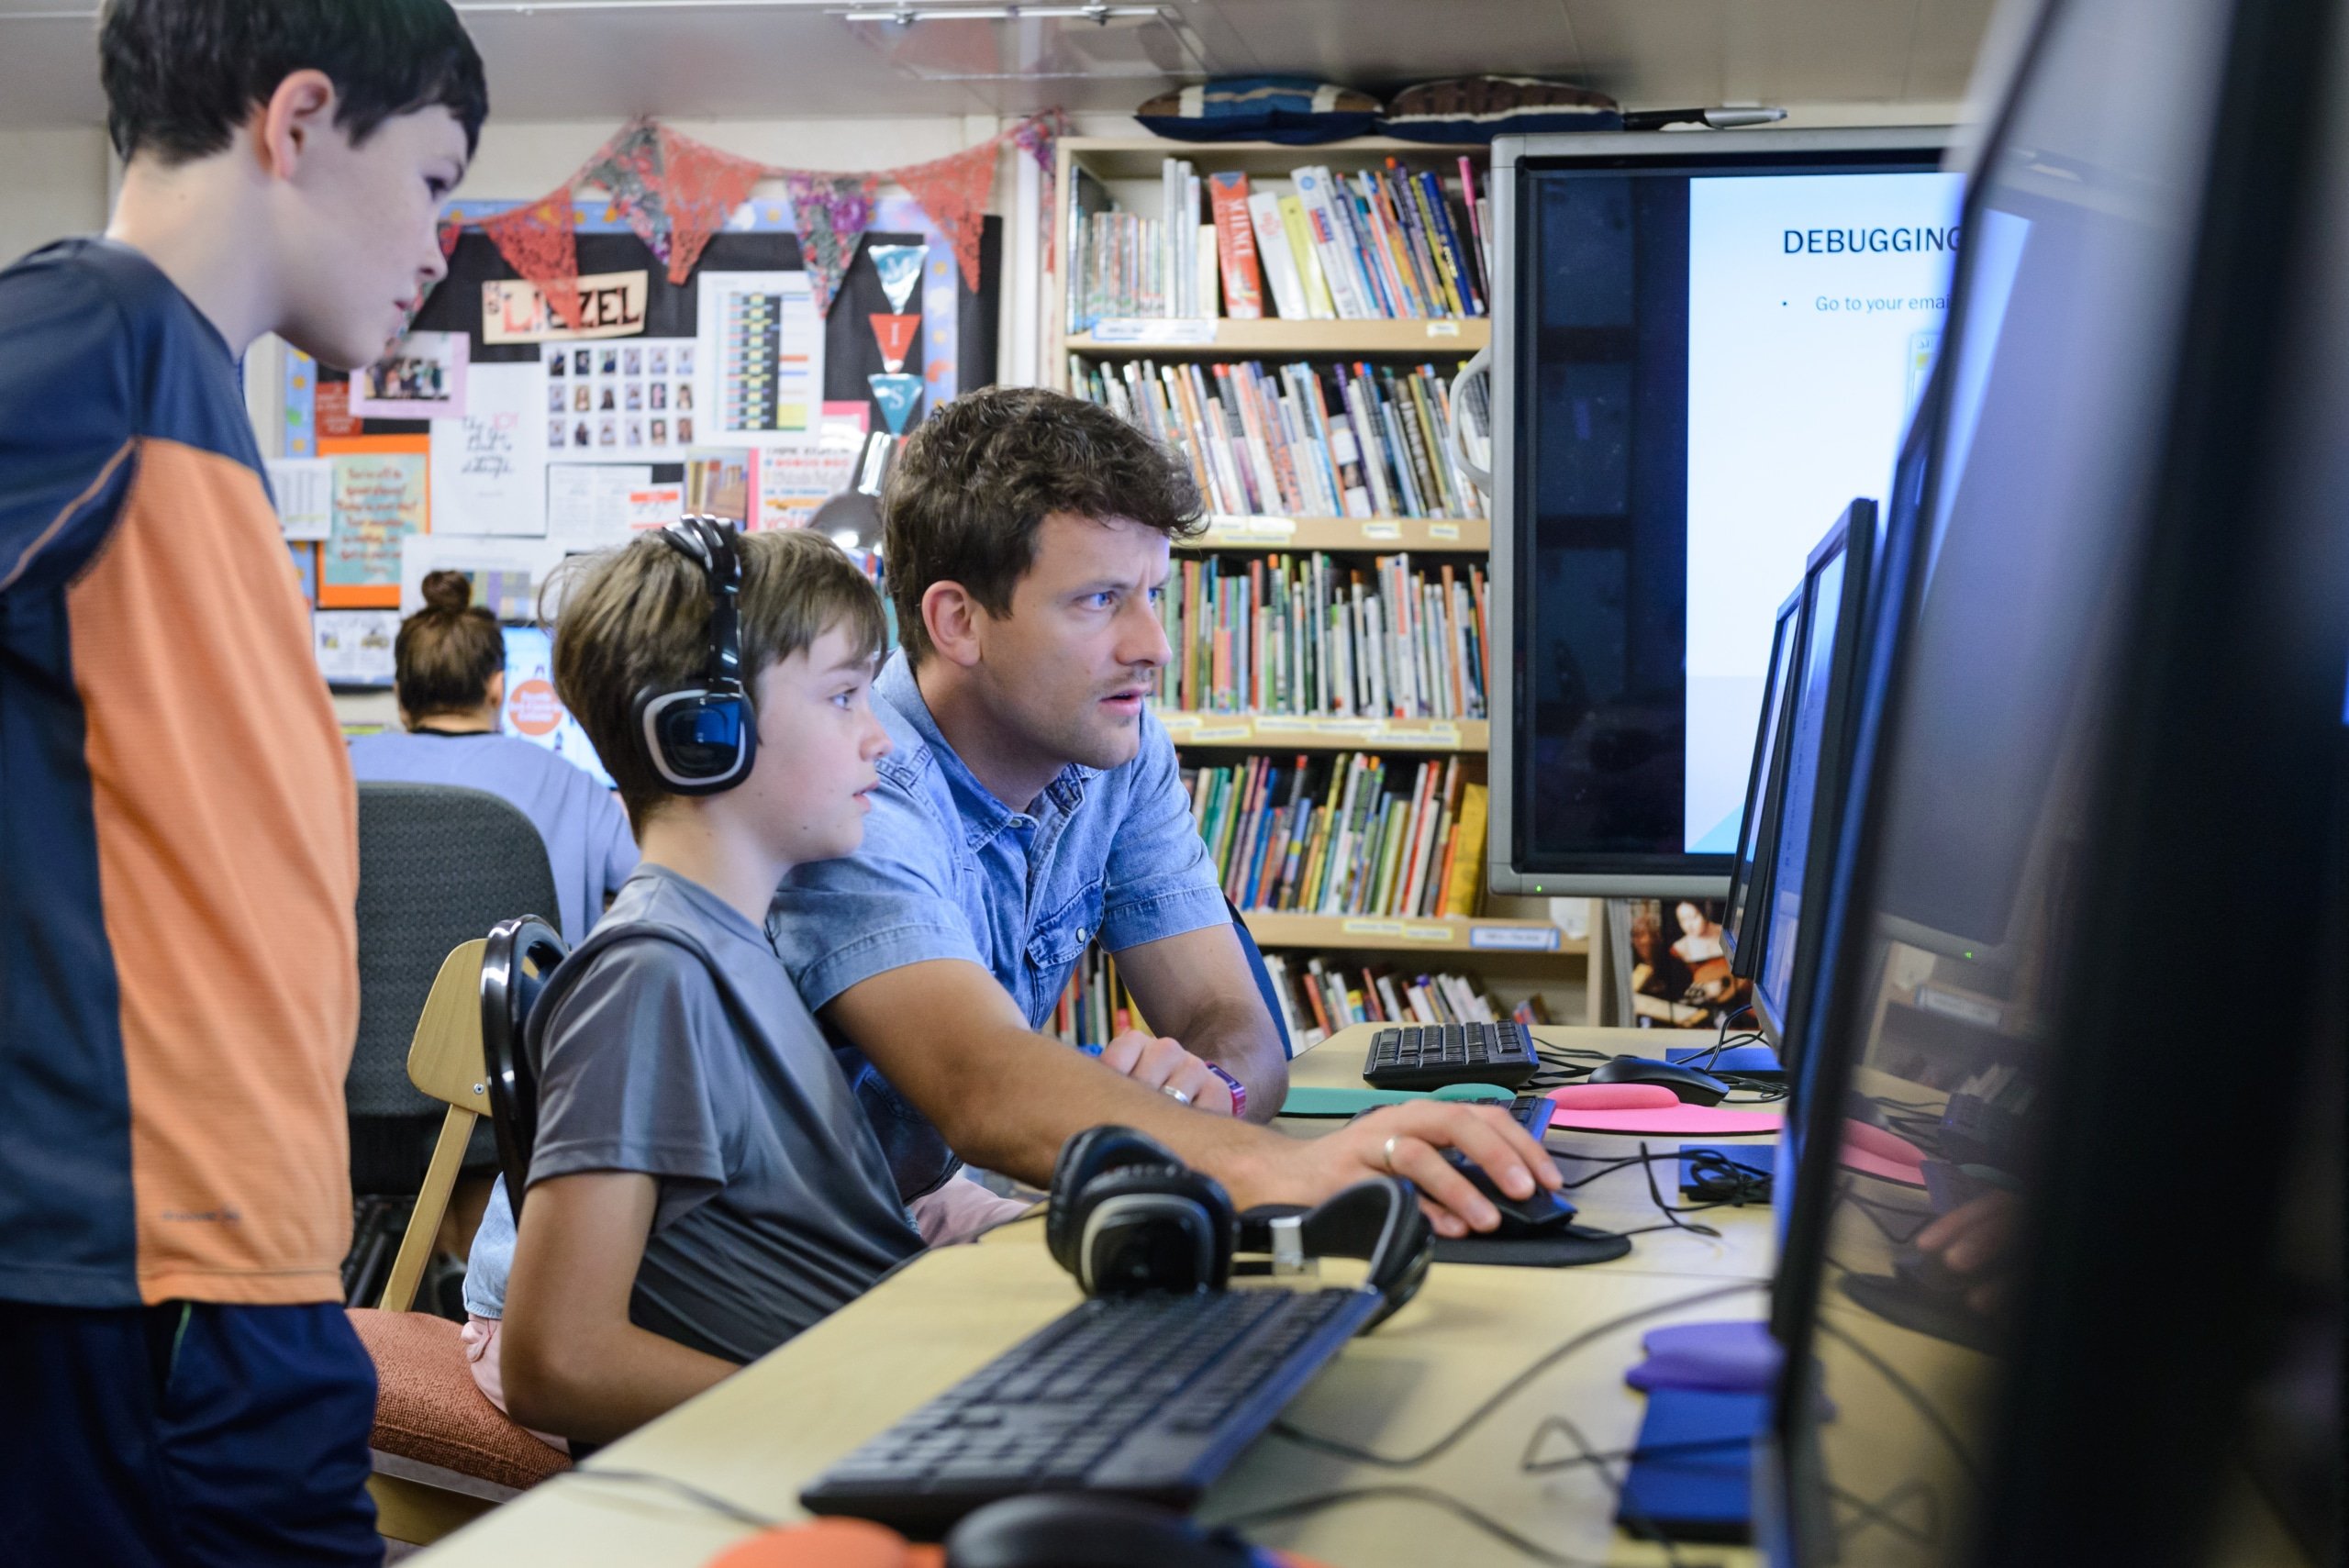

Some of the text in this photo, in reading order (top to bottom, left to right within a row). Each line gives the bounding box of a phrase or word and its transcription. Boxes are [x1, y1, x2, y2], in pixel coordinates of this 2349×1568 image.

[1784, 226, 1961, 253] DEBUGGING
[1815, 294, 1951, 313] Go to your emai
